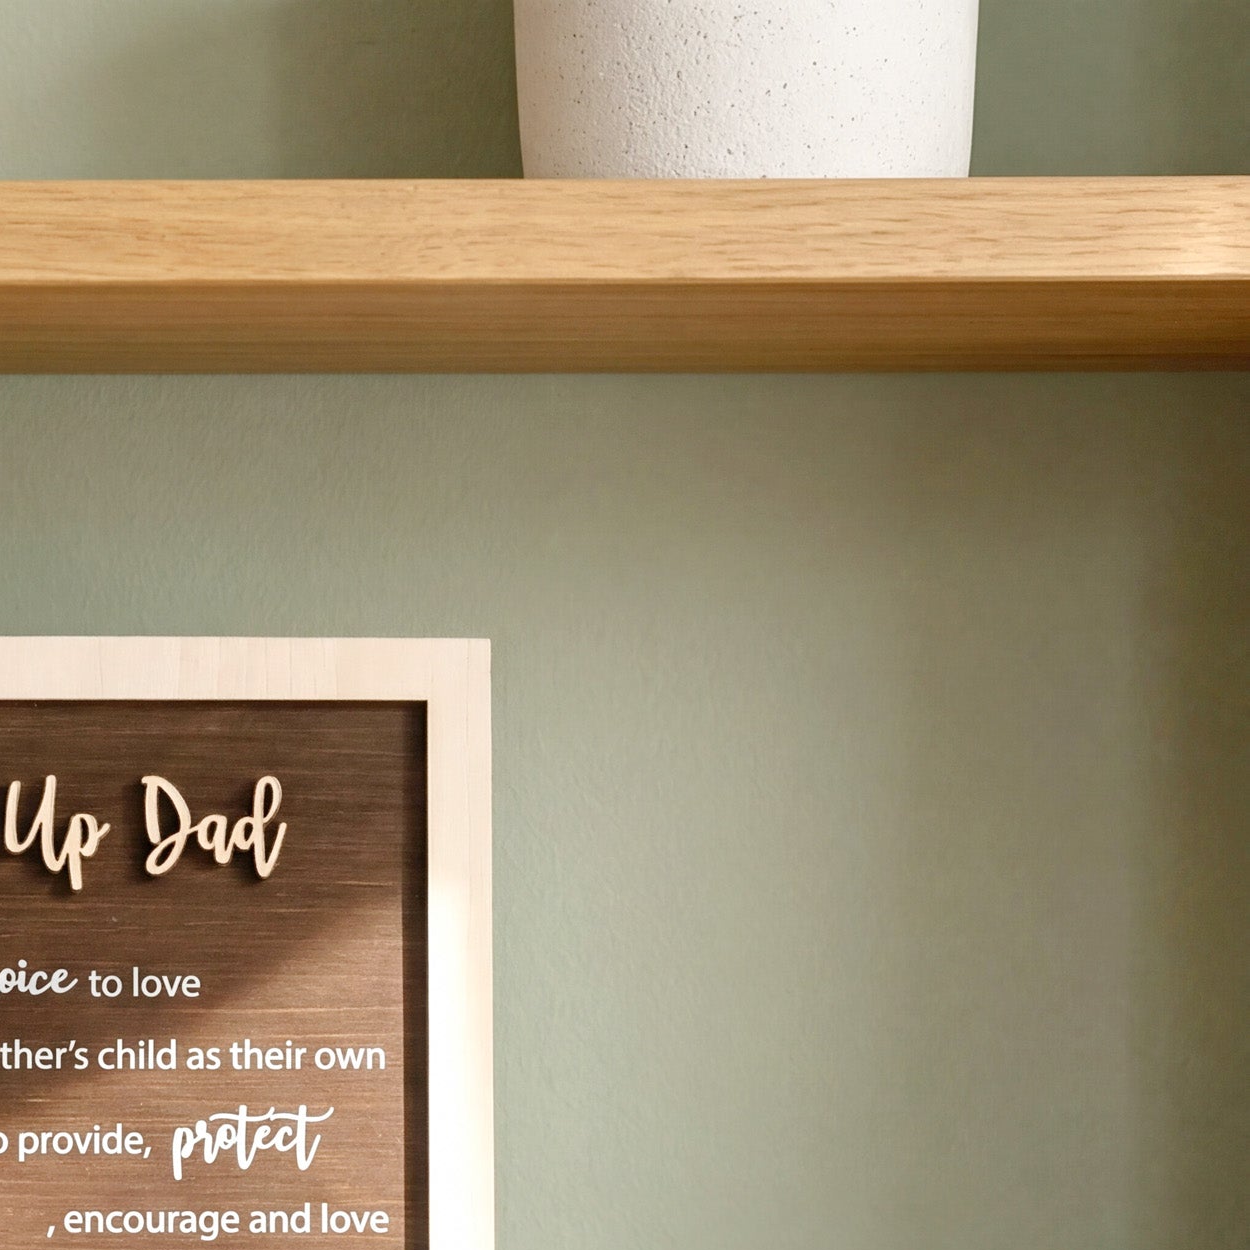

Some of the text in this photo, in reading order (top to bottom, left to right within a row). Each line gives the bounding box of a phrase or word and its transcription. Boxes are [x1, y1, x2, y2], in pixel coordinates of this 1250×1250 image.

[2, 774, 111, 893] Up
[140, 774, 287, 880] Dad
[88, 970, 123, 998] to
[133, 966, 201, 998] love
[97, 1038, 177, 1070] child
[186, 1047, 222, 1070] as
[228, 1038, 307, 1070] their
[314, 1047, 386, 1070] own
[18, 1122, 152, 1163] provide,
[172, 1104, 335, 1181] protect
[63, 1210, 240, 1242] encourage
[248, 1202, 311, 1234] and
[321, 1202, 390, 1234] love
